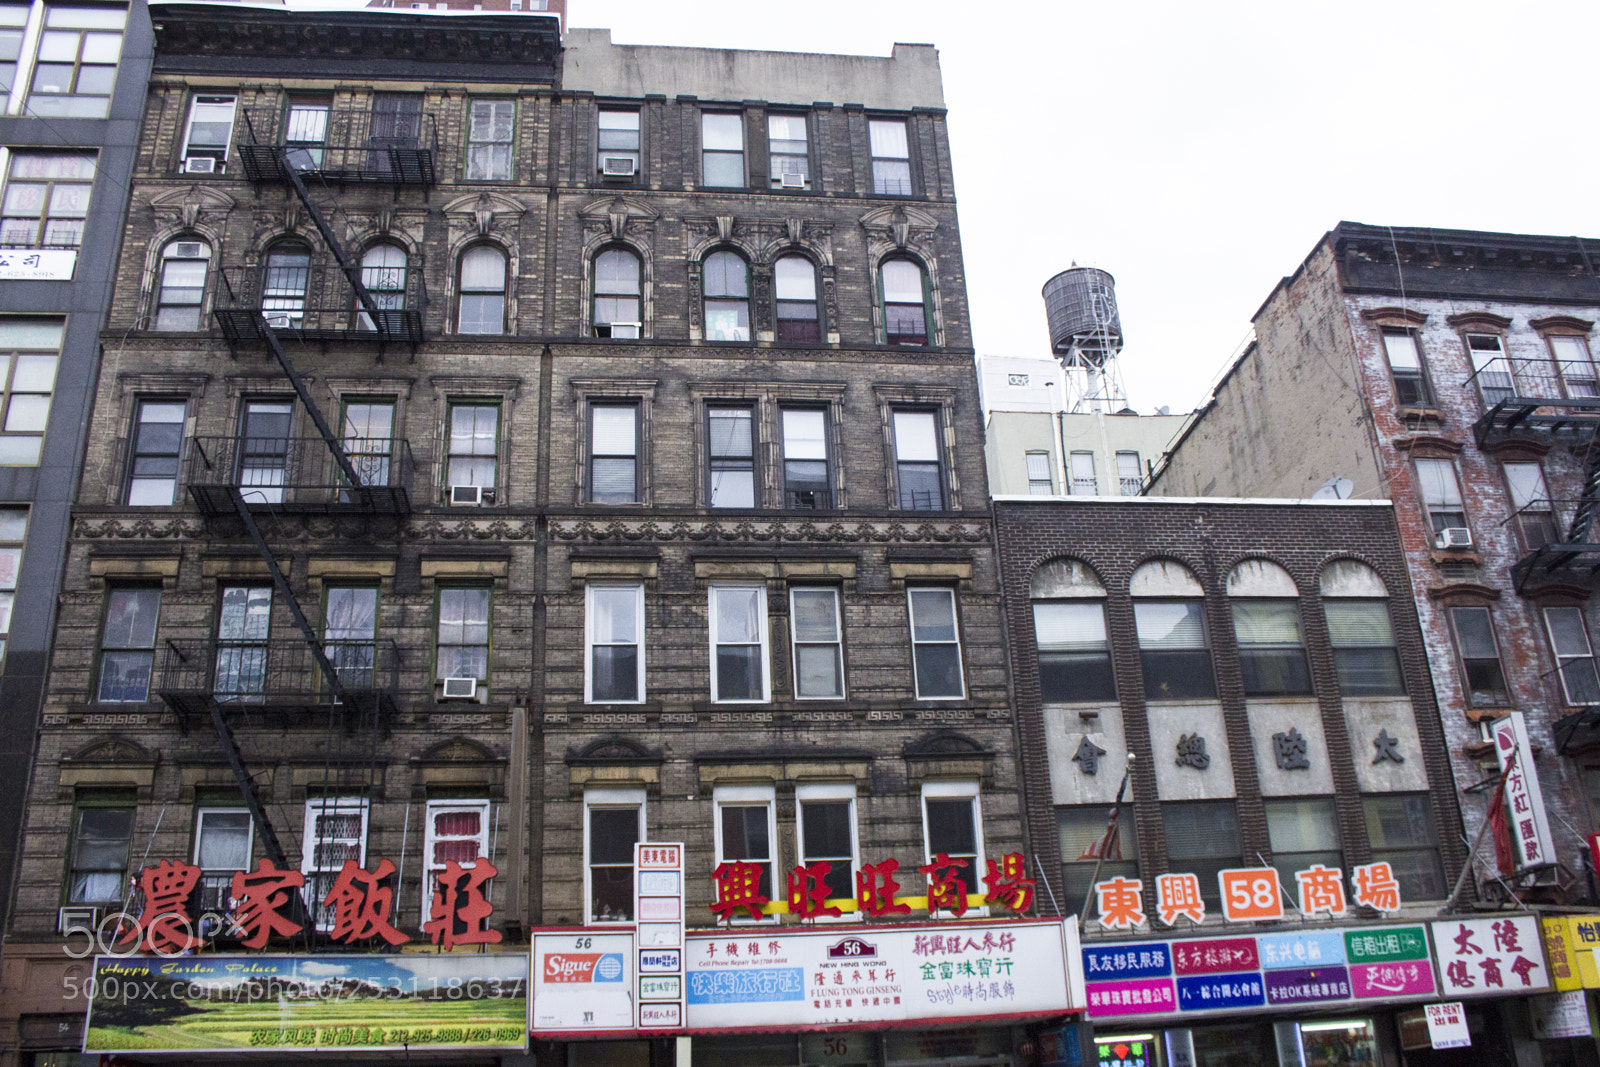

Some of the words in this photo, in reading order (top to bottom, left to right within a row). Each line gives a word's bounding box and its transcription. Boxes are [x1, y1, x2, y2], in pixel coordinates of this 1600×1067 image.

[643, 849, 676, 864] 美東電腦
[708, 852, 1037, 921] 興旺旺商場
[118, 858, 503, 951] 農家飯莊
[575, 938, 592, 949] 56
[706, 941, 781, 958] 手機維修
[843, 941, 861, 955] 56
[1264, 940, 1322, 963] 东兴电脑
[1351, 934, 1401, 956] 信箱出租
[101, 963, 150, 976] Happy
[160, 963, 214, 974] Garden
[225, 962, 277, 973] Palace
[546, 956, 592, 976] Sigue
[692, 969, 801, 995] 快樂旅行社
[842, 987, 865, 996] TONG
[866, 985, 902, 995] GINSENG
[1427, 1006, 1441, 1017] FOR
[1443, 1004, 1461, 1016] RENT
[249, 1028, 316, 1046] 农家风味
[319, 1026, 387, 1045] 时尚美食
[389, 1028, 461, 1043] 212-925-9888
[471, 1028, 520, 1042] 226-0969
[823, 1037, 847, 1056] 56
